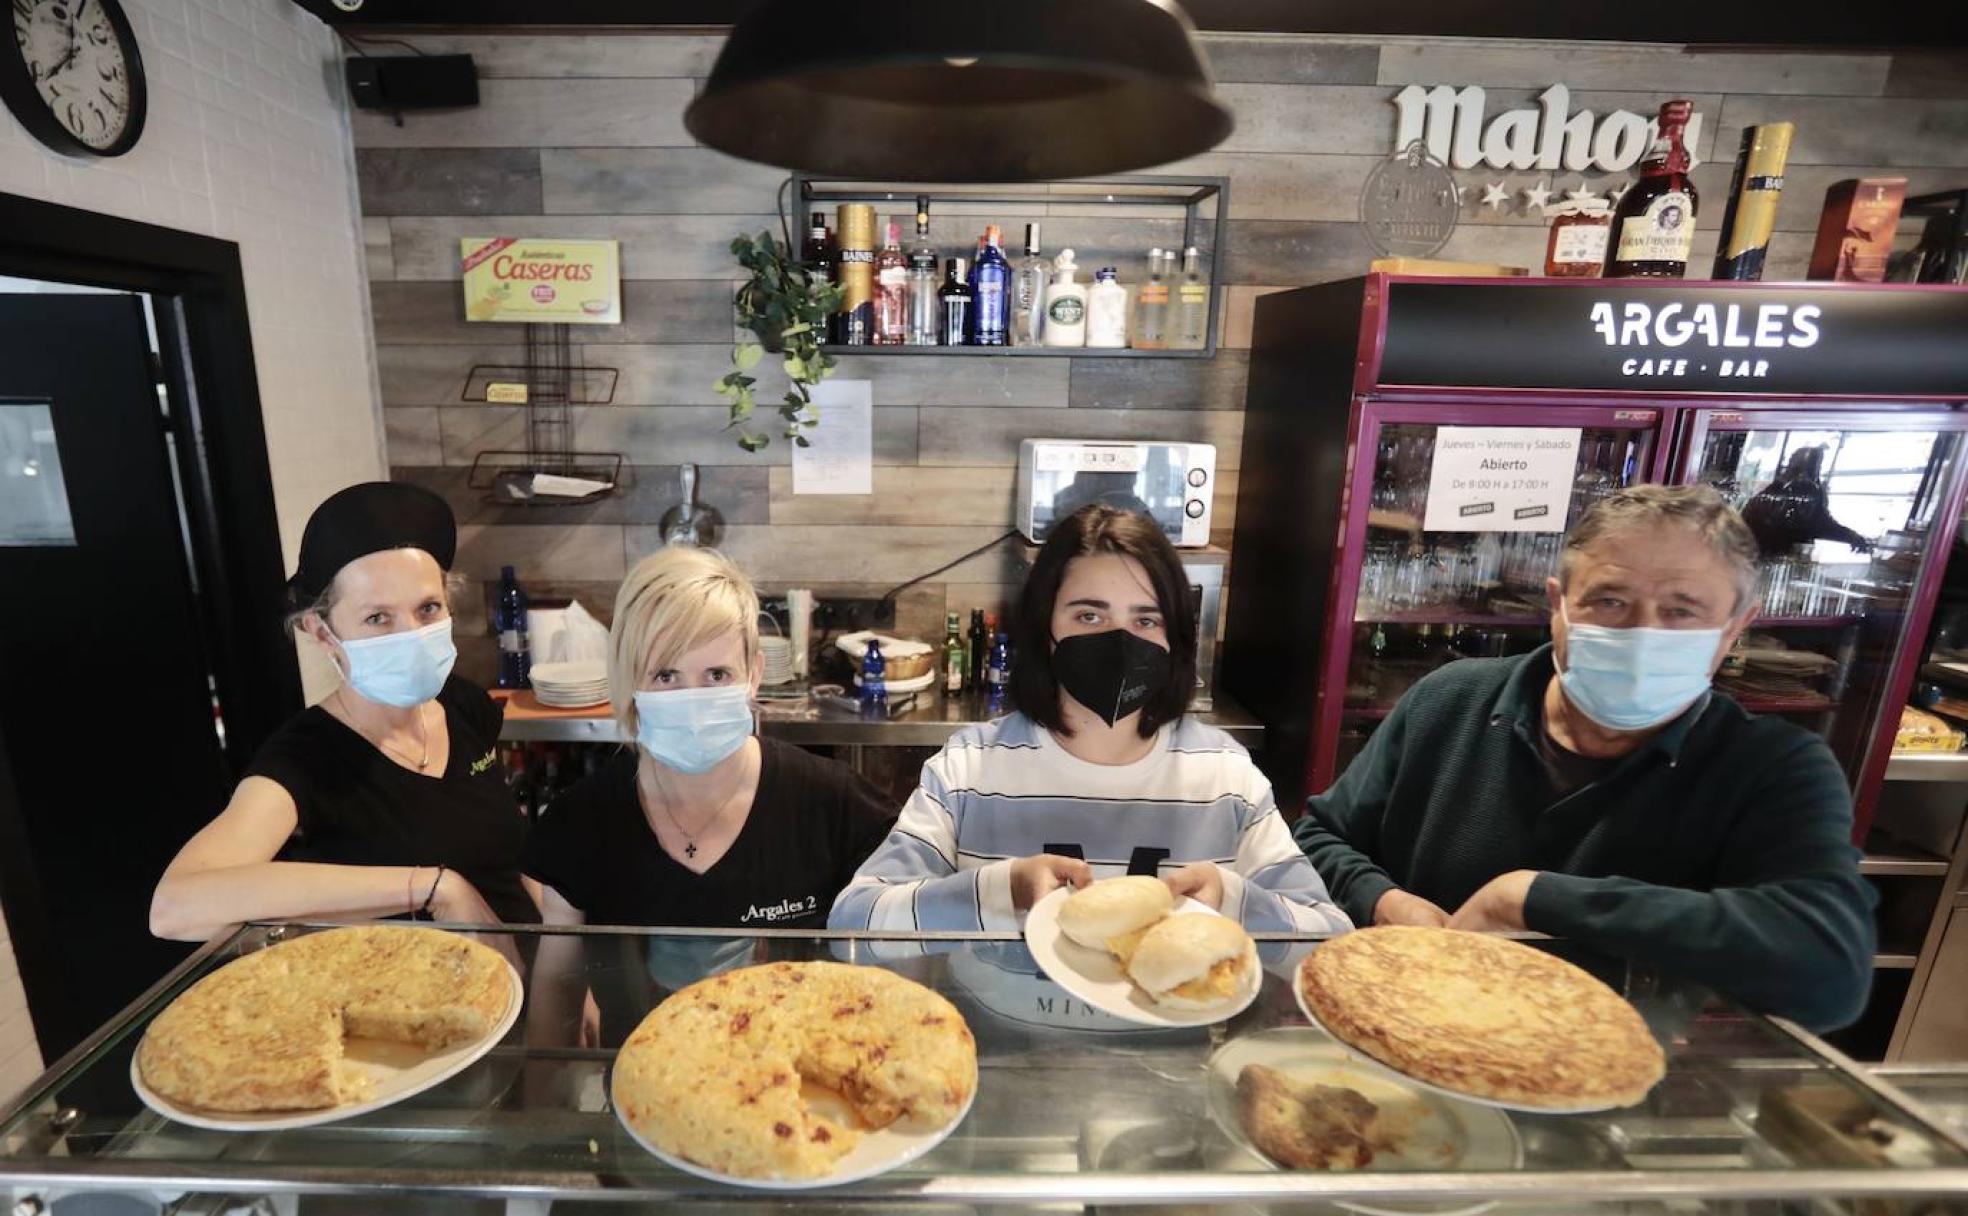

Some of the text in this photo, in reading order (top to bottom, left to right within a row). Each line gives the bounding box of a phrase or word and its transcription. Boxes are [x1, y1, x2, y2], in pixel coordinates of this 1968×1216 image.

[493, 254, 593, 281] Caseras
[1590, 302, 1821, 348] ARGALES
[1622, 358, 1688, 377] CAFE
[1719, 360, 1769, 377] BAR
[1442, 439, 1475, 449] Jueves
[1487, 439, 1524, 449] Viernes
[1479, 458, 1528, 471] Abierto
[1452, 480, 1466, 489] De
[1493, 480, 1501, 489] H
[1540, 480, 1549, 489] H
[741, 899, 804, 922] Argales
[806, 896, 817, 909] 2
